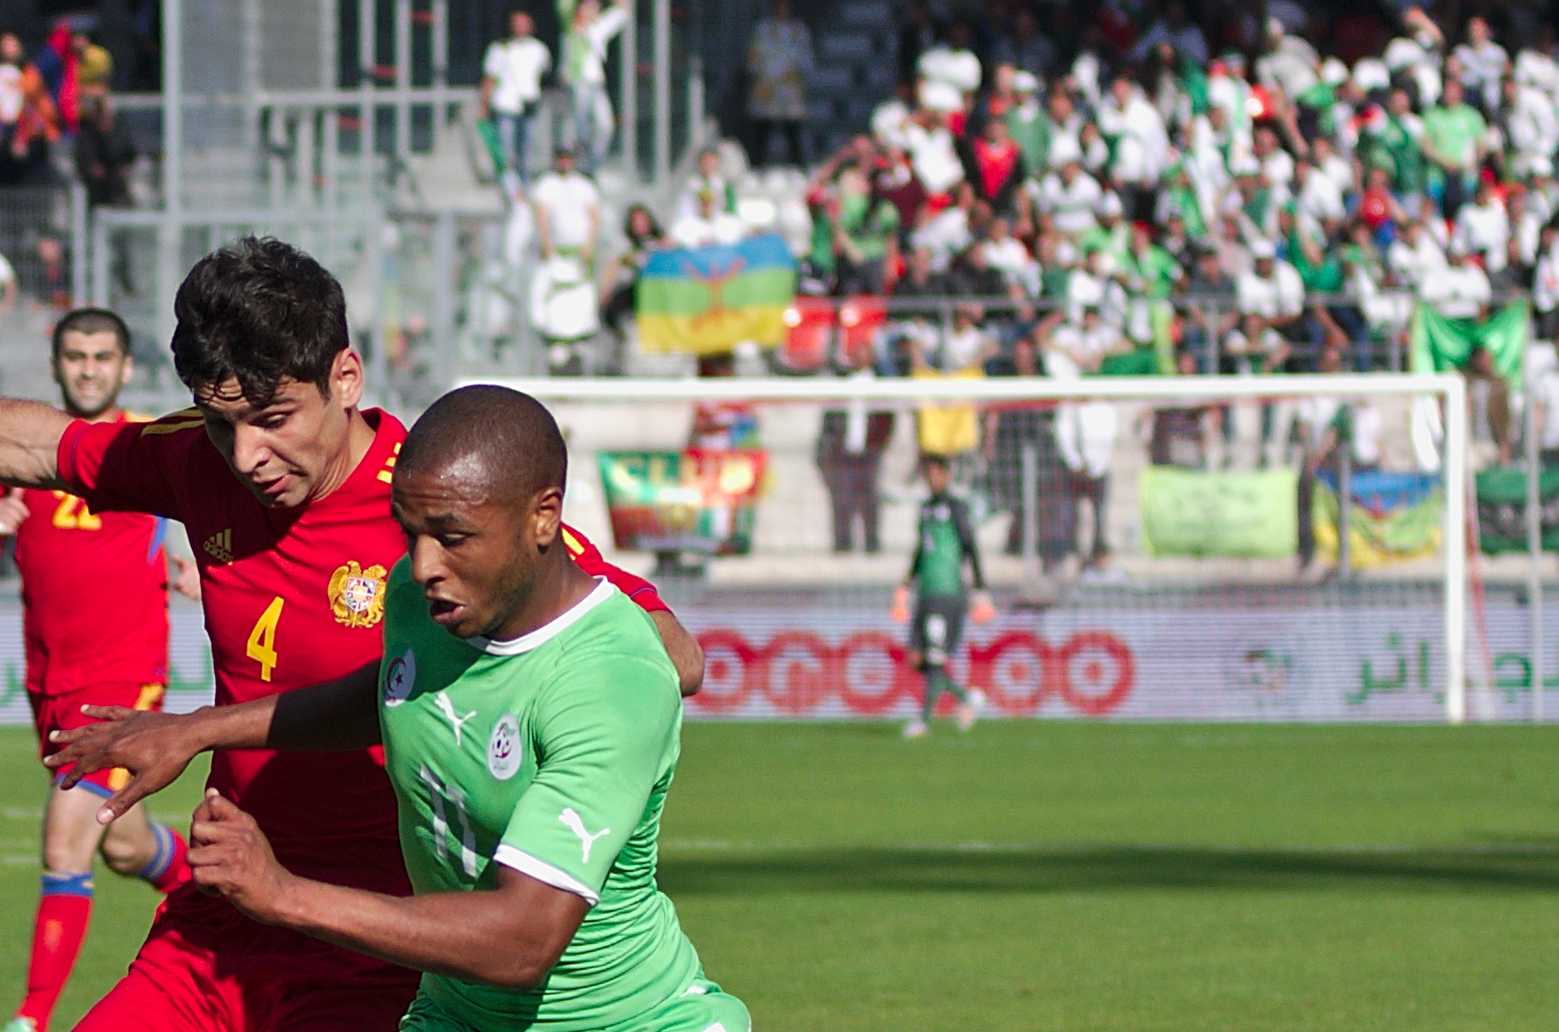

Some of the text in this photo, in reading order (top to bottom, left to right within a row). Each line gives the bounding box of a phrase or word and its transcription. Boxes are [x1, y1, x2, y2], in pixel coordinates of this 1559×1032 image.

[203, 541, 234, 566] adidas
[247, 596, 284, 682] 4
[420, 763, 478, 877] 11
